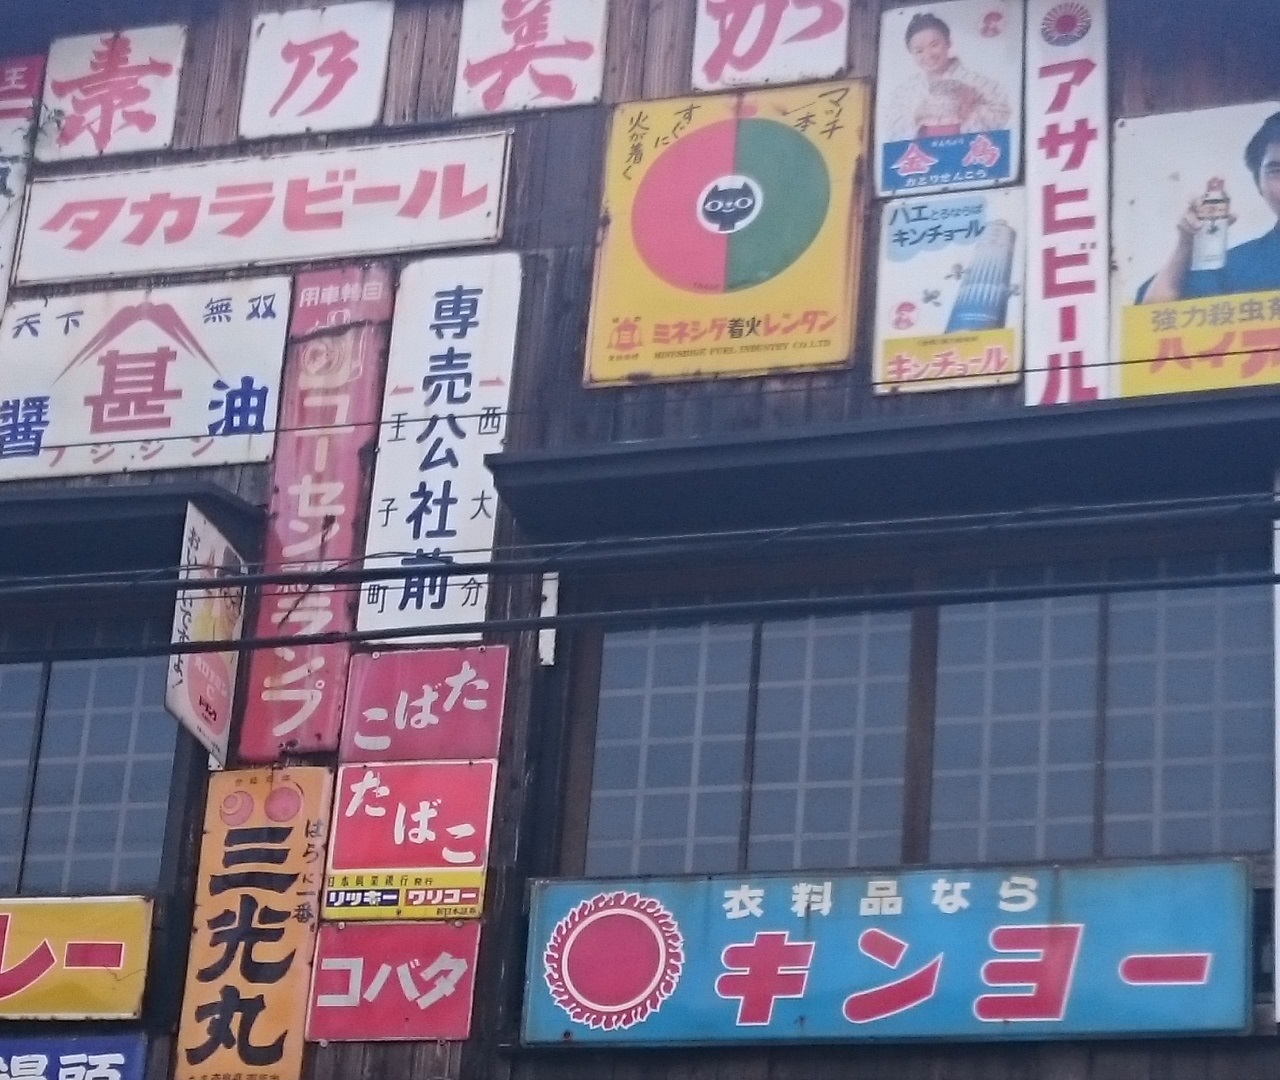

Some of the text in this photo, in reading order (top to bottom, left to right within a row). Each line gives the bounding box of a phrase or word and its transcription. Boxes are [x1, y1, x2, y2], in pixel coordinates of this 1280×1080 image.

[269, 31, 360, 119] 乃
[818, 87, 850, 140] マッチ
[39, 162, 494, 251] タカラビール
[892, 219, 986, 248] キンチョール
[1035, 56, 1100, 406] アサヒビール
[12, 293, 277, 339] 天下 無双
[83, 346, 183, 435] 甚
[207, 375, 269, 436] 油
[887, 347, 1009, 381] キンチョール
[398, 284, 484, 610] 専売公社前
[460, 406, 503, 608] 西大分
[345, 769, 477, 865] たばこ
[407, 889, 477, 906] ワリコー
[723, 876, 1040, 920] 衣料品なら
[184, 825, 301, 1068] 三光丸
[714, 922, 1213, 1027] キンヨー
